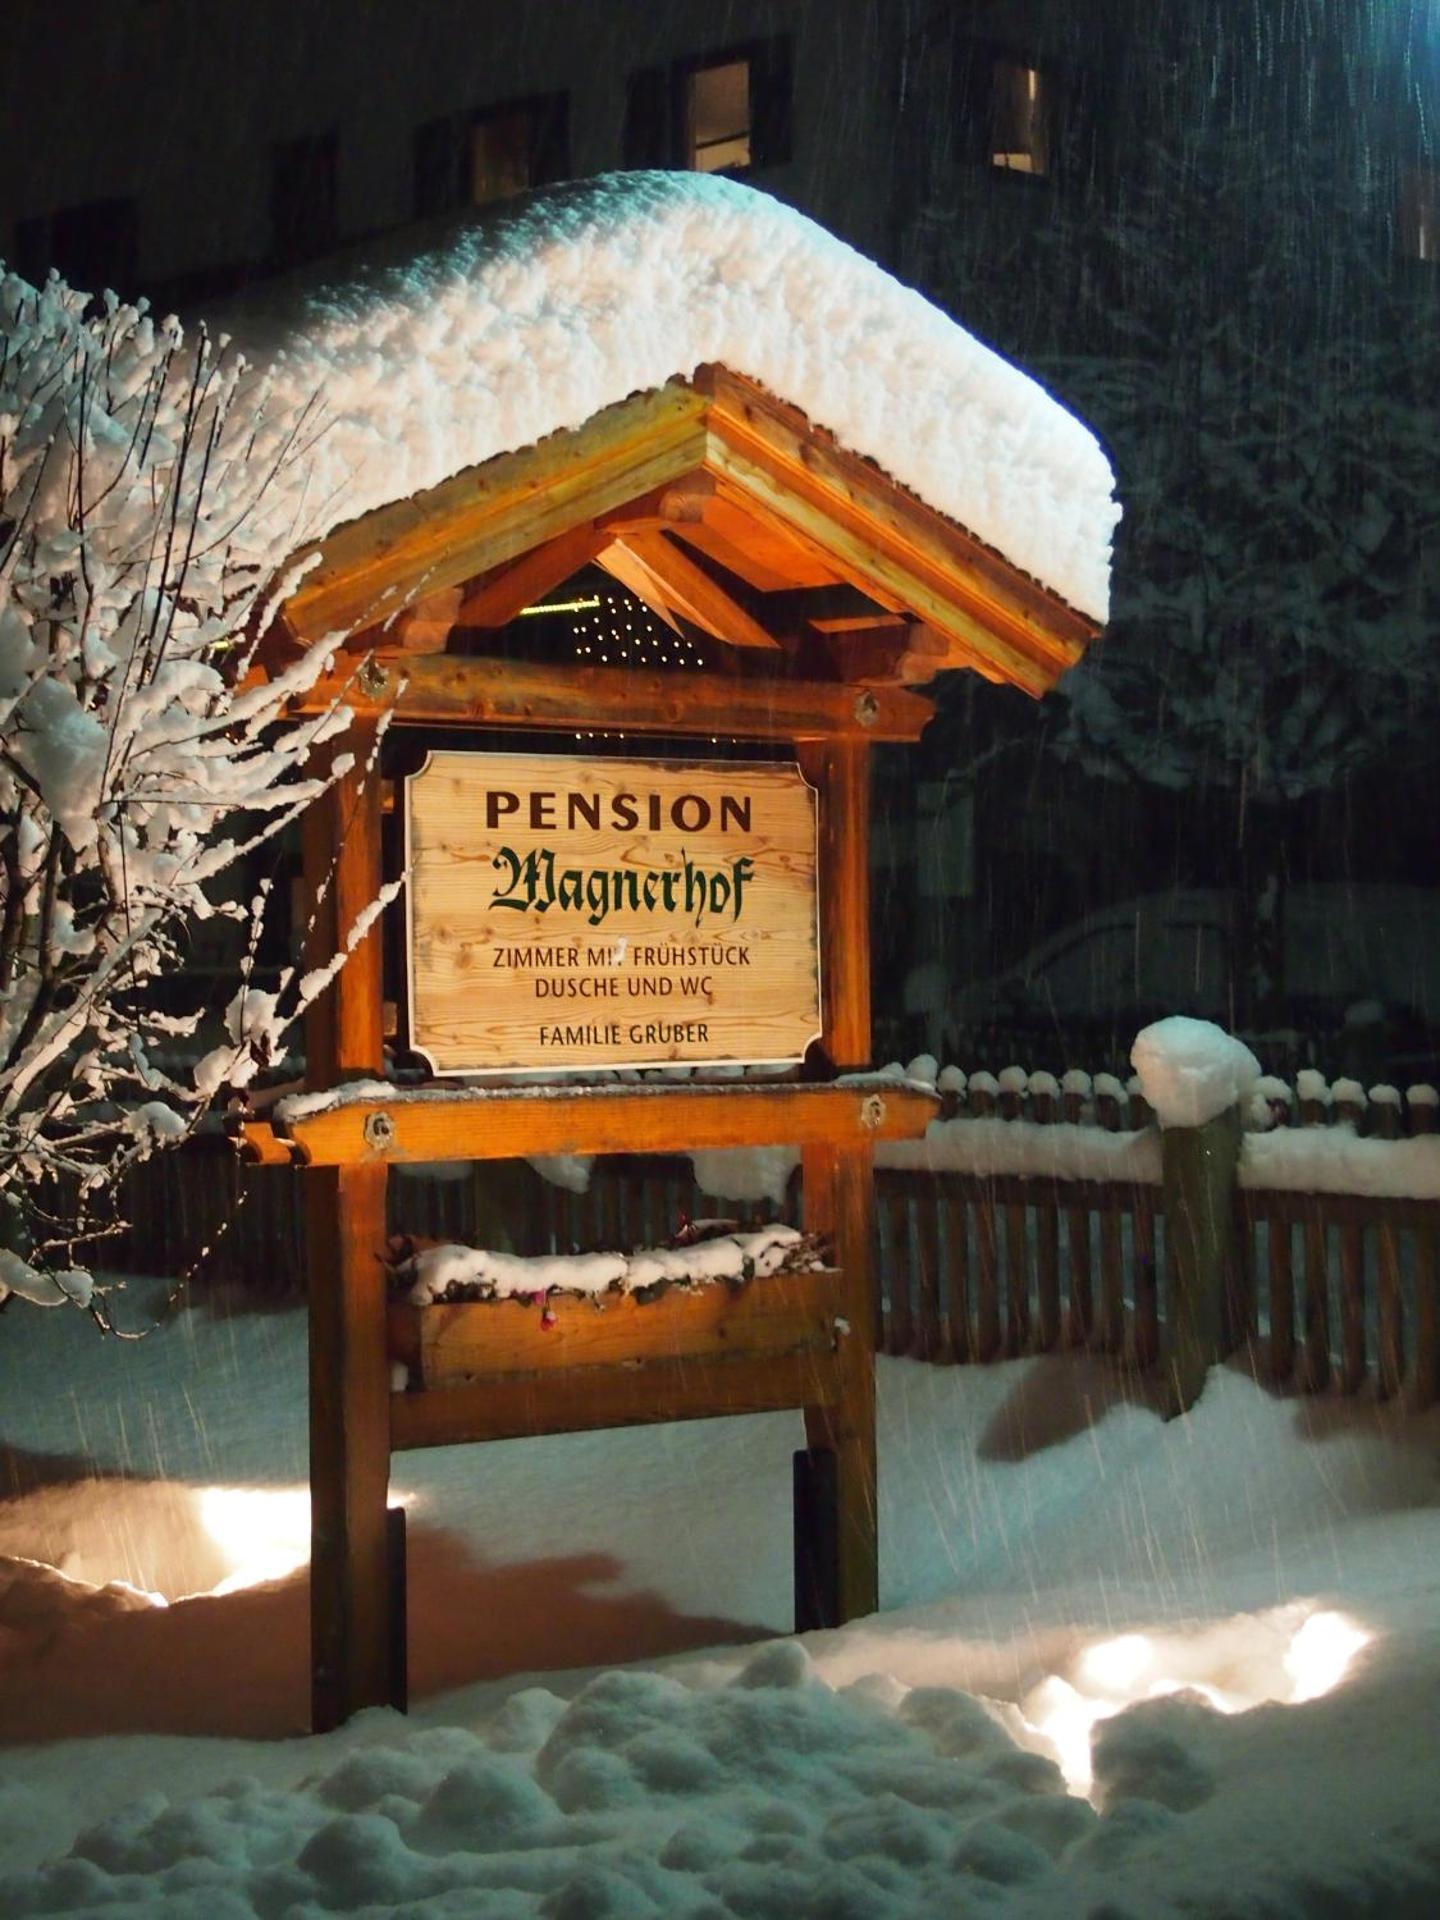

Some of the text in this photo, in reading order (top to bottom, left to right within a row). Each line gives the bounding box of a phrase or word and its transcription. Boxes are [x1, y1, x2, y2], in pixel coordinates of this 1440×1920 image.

[486, 791, 752, 832] PENSION
[493, 947, 579, 967] ZIMMER
[634, 943, 750, 966] FRÜHSTÜCK
[535, 976, 713, 997] DUSCHE UND WC
[540, 1024, 709, 1046] FAMILIE GRUBER
